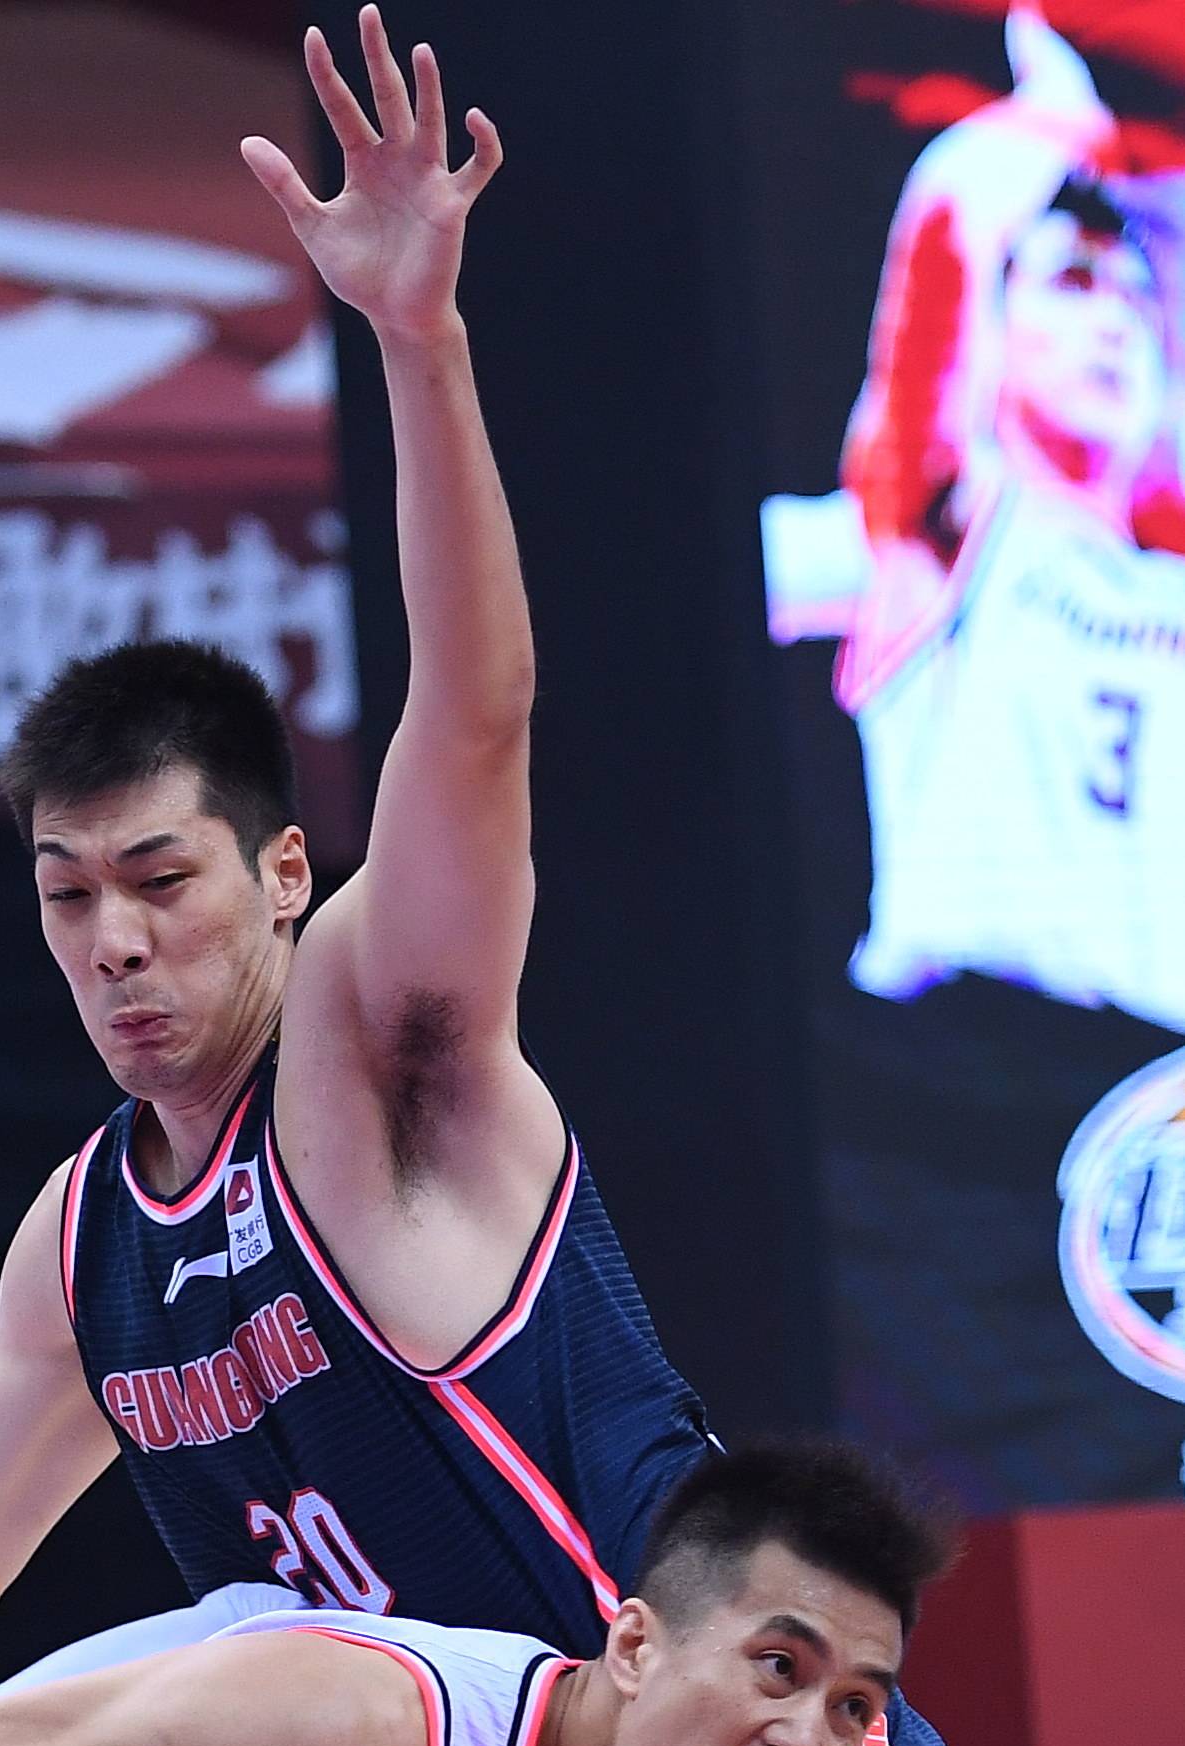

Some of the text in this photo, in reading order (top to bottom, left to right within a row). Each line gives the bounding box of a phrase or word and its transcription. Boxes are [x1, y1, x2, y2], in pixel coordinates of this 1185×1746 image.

[1089, 690, 1142, 820] 3
[237, 1238, 264, 1264] CGB
[246, 1487, 396, 1617] 20
